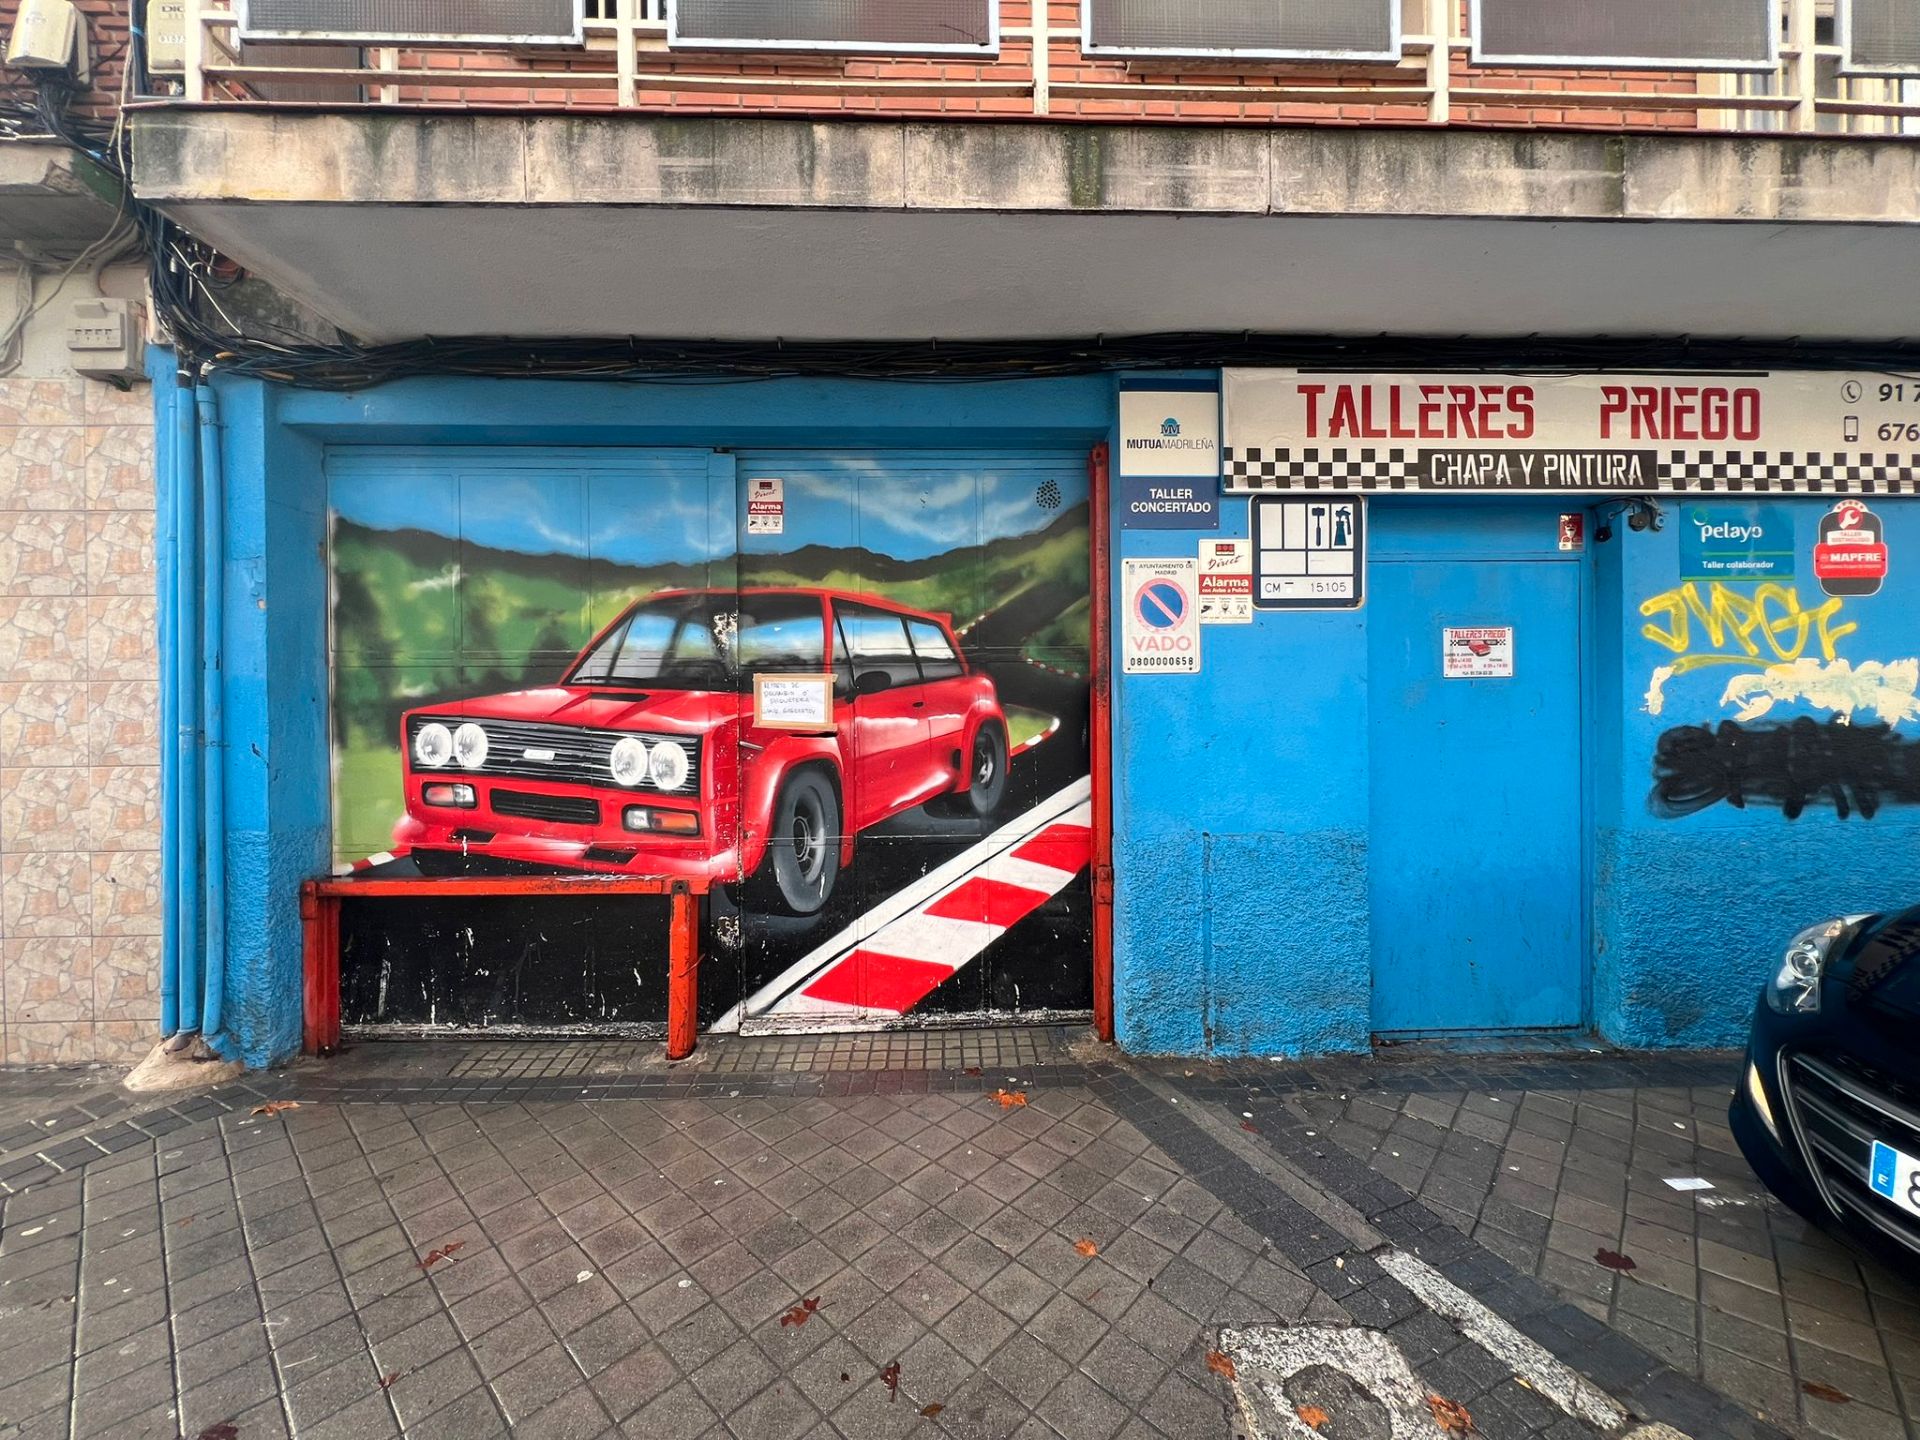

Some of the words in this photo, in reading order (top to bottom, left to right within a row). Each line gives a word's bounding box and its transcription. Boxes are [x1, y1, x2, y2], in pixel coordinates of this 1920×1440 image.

[1879, 383, 1903, 402] 91
[1297, 385, 1534, 439] TALLERES
[1600, 386, 1760, 440] PRIEGO
[1878, 423, 1920, 442] 676
[1126, 438, 1214, 450] MUTUAMADRILEÑA
[1431, 453, 1512, 486] CHAPA
[1519, 454, 1536, 486] Y
[1543, 454, 1645, 487] PINTURA
[1149, 488, 1193, 499] TALLER
[750, 502, 781, 510] Alarma
[1130, 501, 1211, 513] CONCERTADO
[1701, 522, 1762, 543] pelayo
[1208, 554, 1244, 570] Direct
[1829, 553, 1881, 562] MAPFRE
[1702, 561, 1724, 569] Taller
[1726, 561, 1774, 569] colaborador
[1202, 575, 1249, 587] Alarma
[1265, 582, 1281, 593] CM
[1311, 582, 1347, 593] 15105
[1450, 630, 1482, 638] TALLERES
[1484, 630, 1506, 638] PRIEGO
[1132, 636, 1192, 652] VADO
[1878, 1173, 1889, 1187] E
